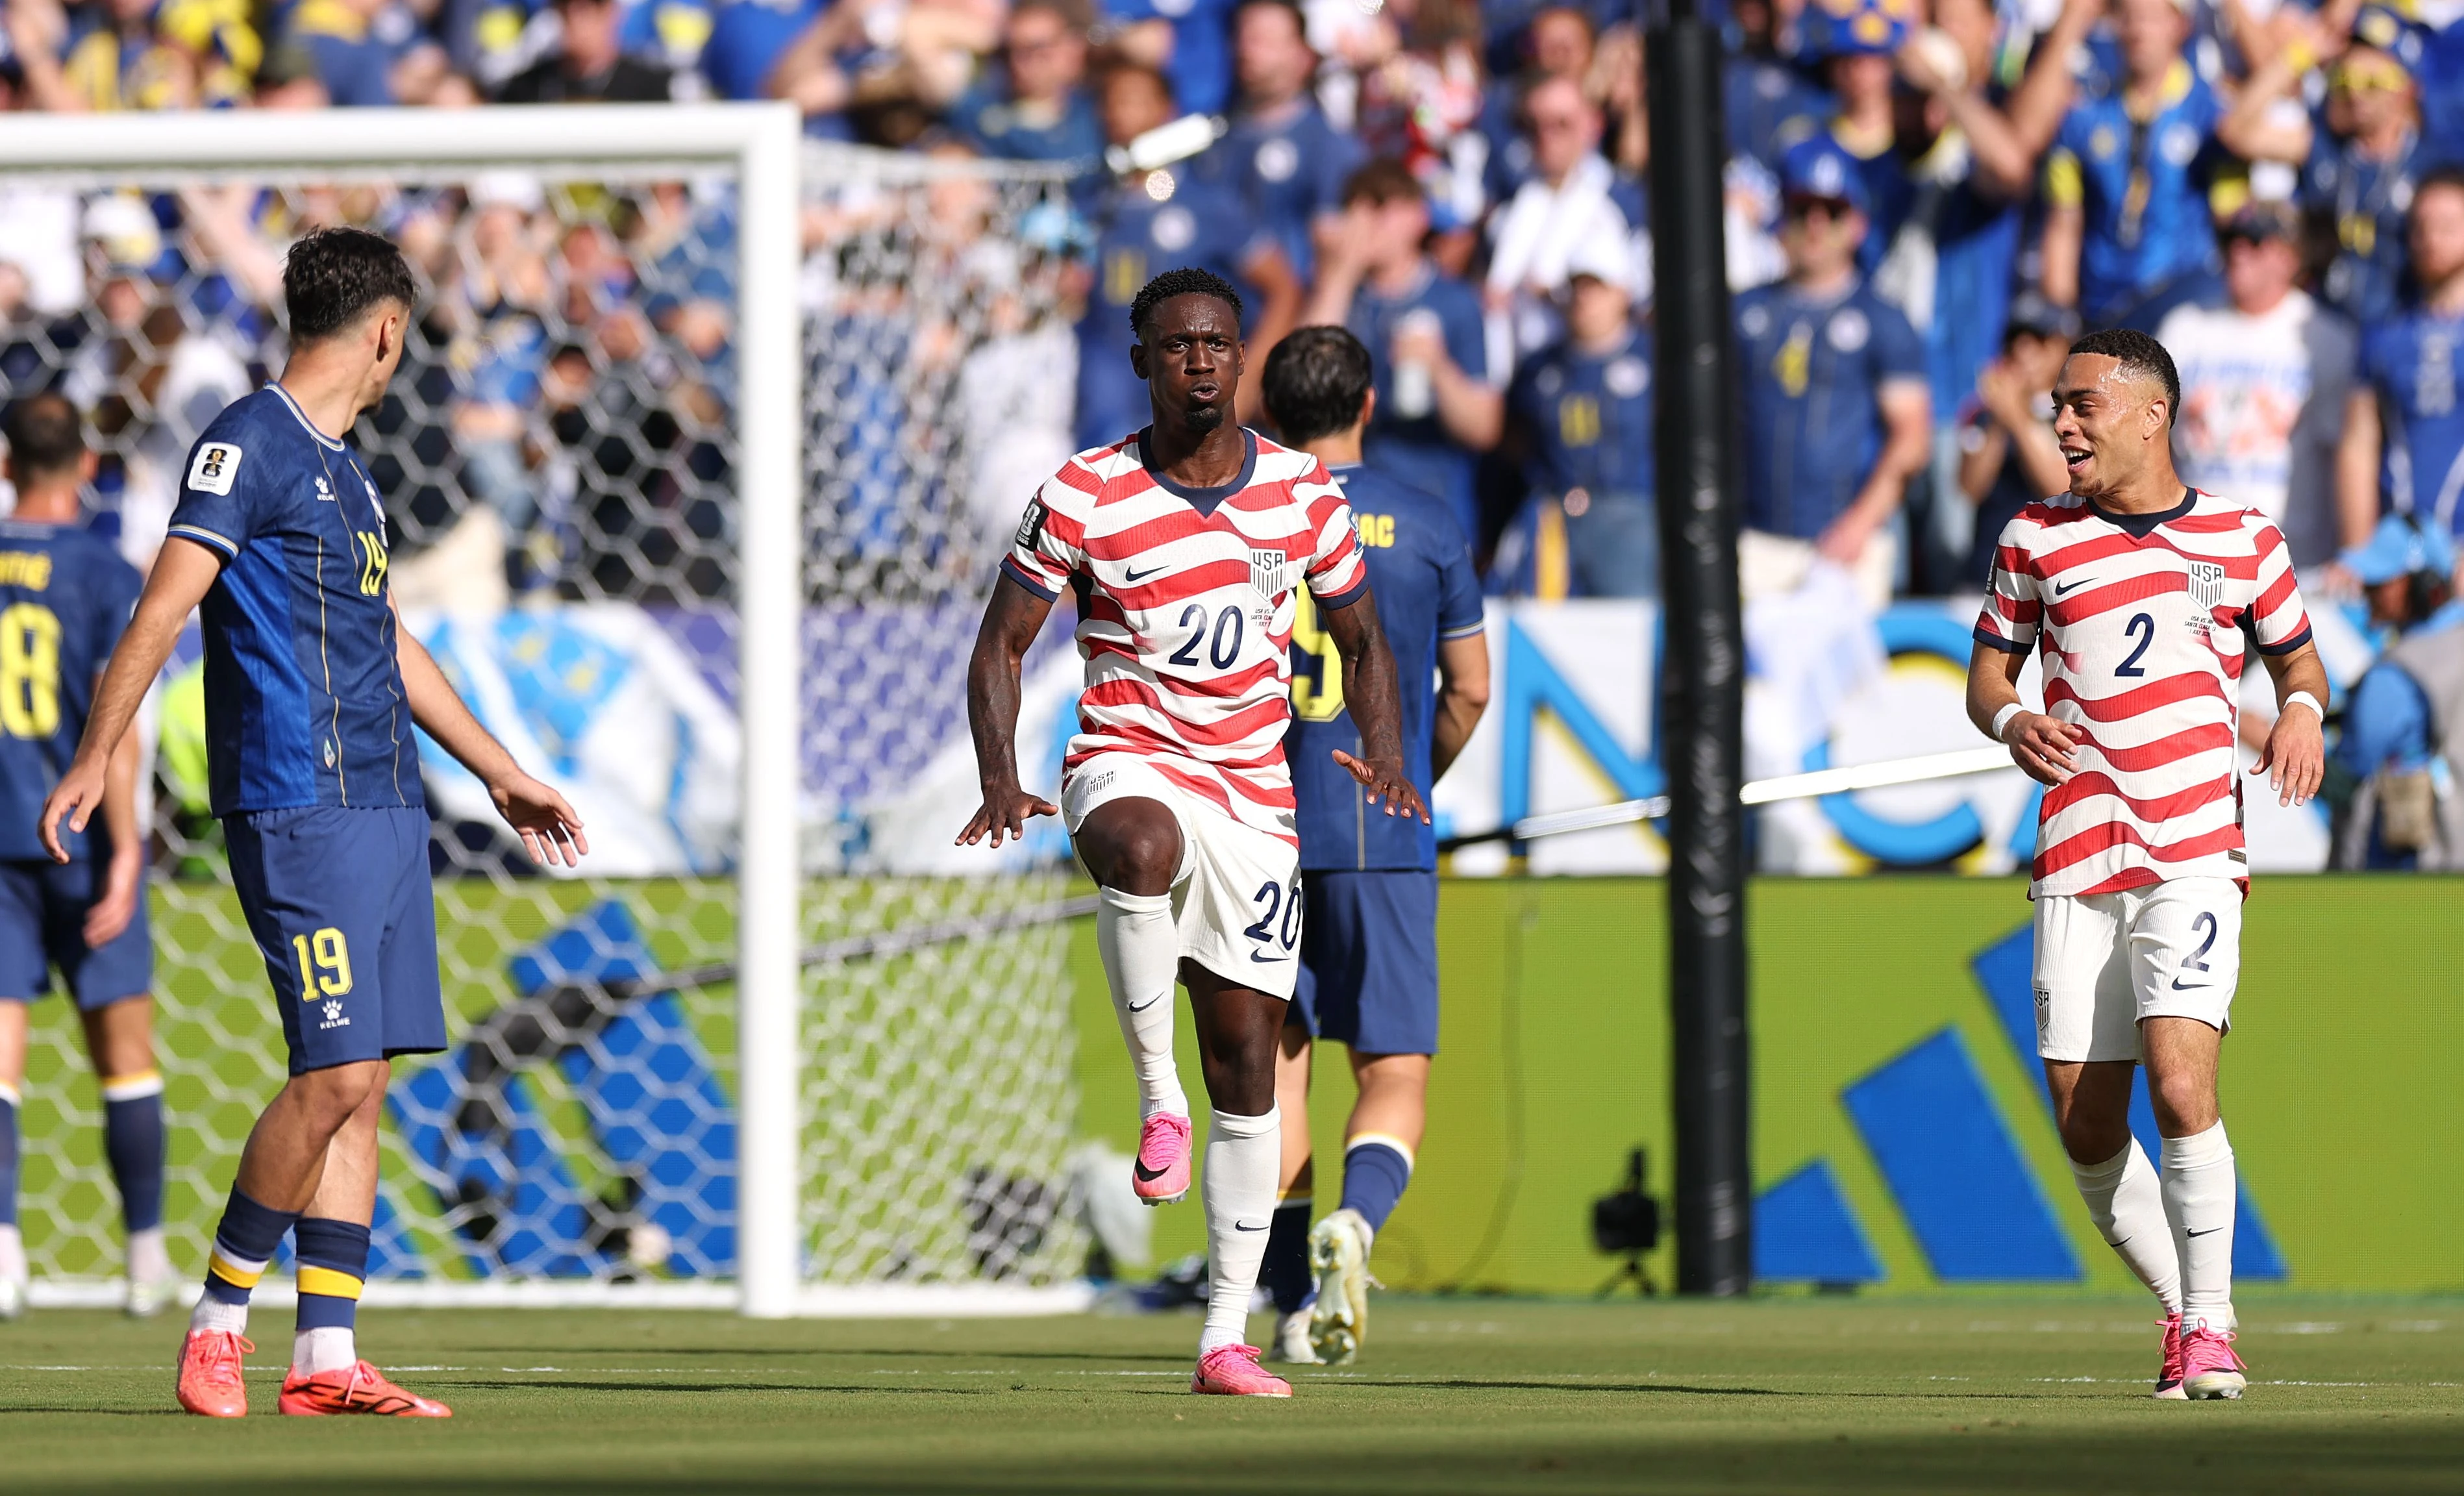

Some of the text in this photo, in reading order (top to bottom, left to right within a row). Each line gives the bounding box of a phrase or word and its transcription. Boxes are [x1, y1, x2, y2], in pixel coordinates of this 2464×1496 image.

[356, 530, 388, 597] 19
[1252, 551, 1283, 571] USA
[2191, 563, 2222, 582] USA
[1168, 603, 1243, 670] 20
[2114, 612, 2154, 677] 2
[0, 601, 64, 740] 8
[1090, 771, 1114, 784] USA
[1243, 880, 1301, 951] 20
[2180, 911, 2217, 973] 2
[292, 927, 353, 1003] 19
[319, 1017, 351, 1030] KELME
[2034, 989, 2049, 1006] USA
